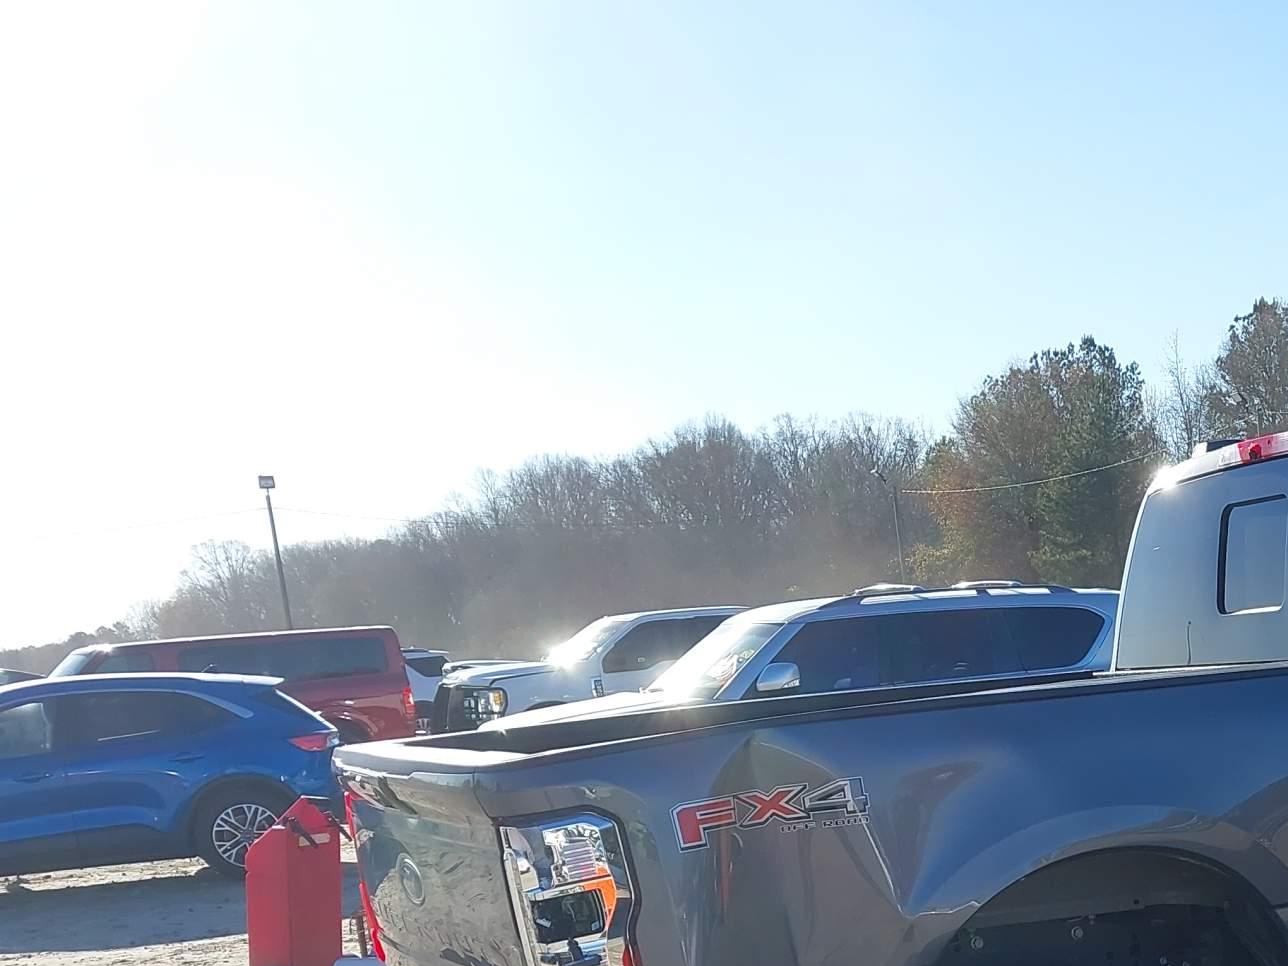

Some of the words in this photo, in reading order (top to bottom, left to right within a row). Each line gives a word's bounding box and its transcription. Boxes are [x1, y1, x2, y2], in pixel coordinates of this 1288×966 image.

[669, 776, 871, 853] FX4
[779, 821, 817, 833] OFF
[822, 816, 870, 829] ROAD
